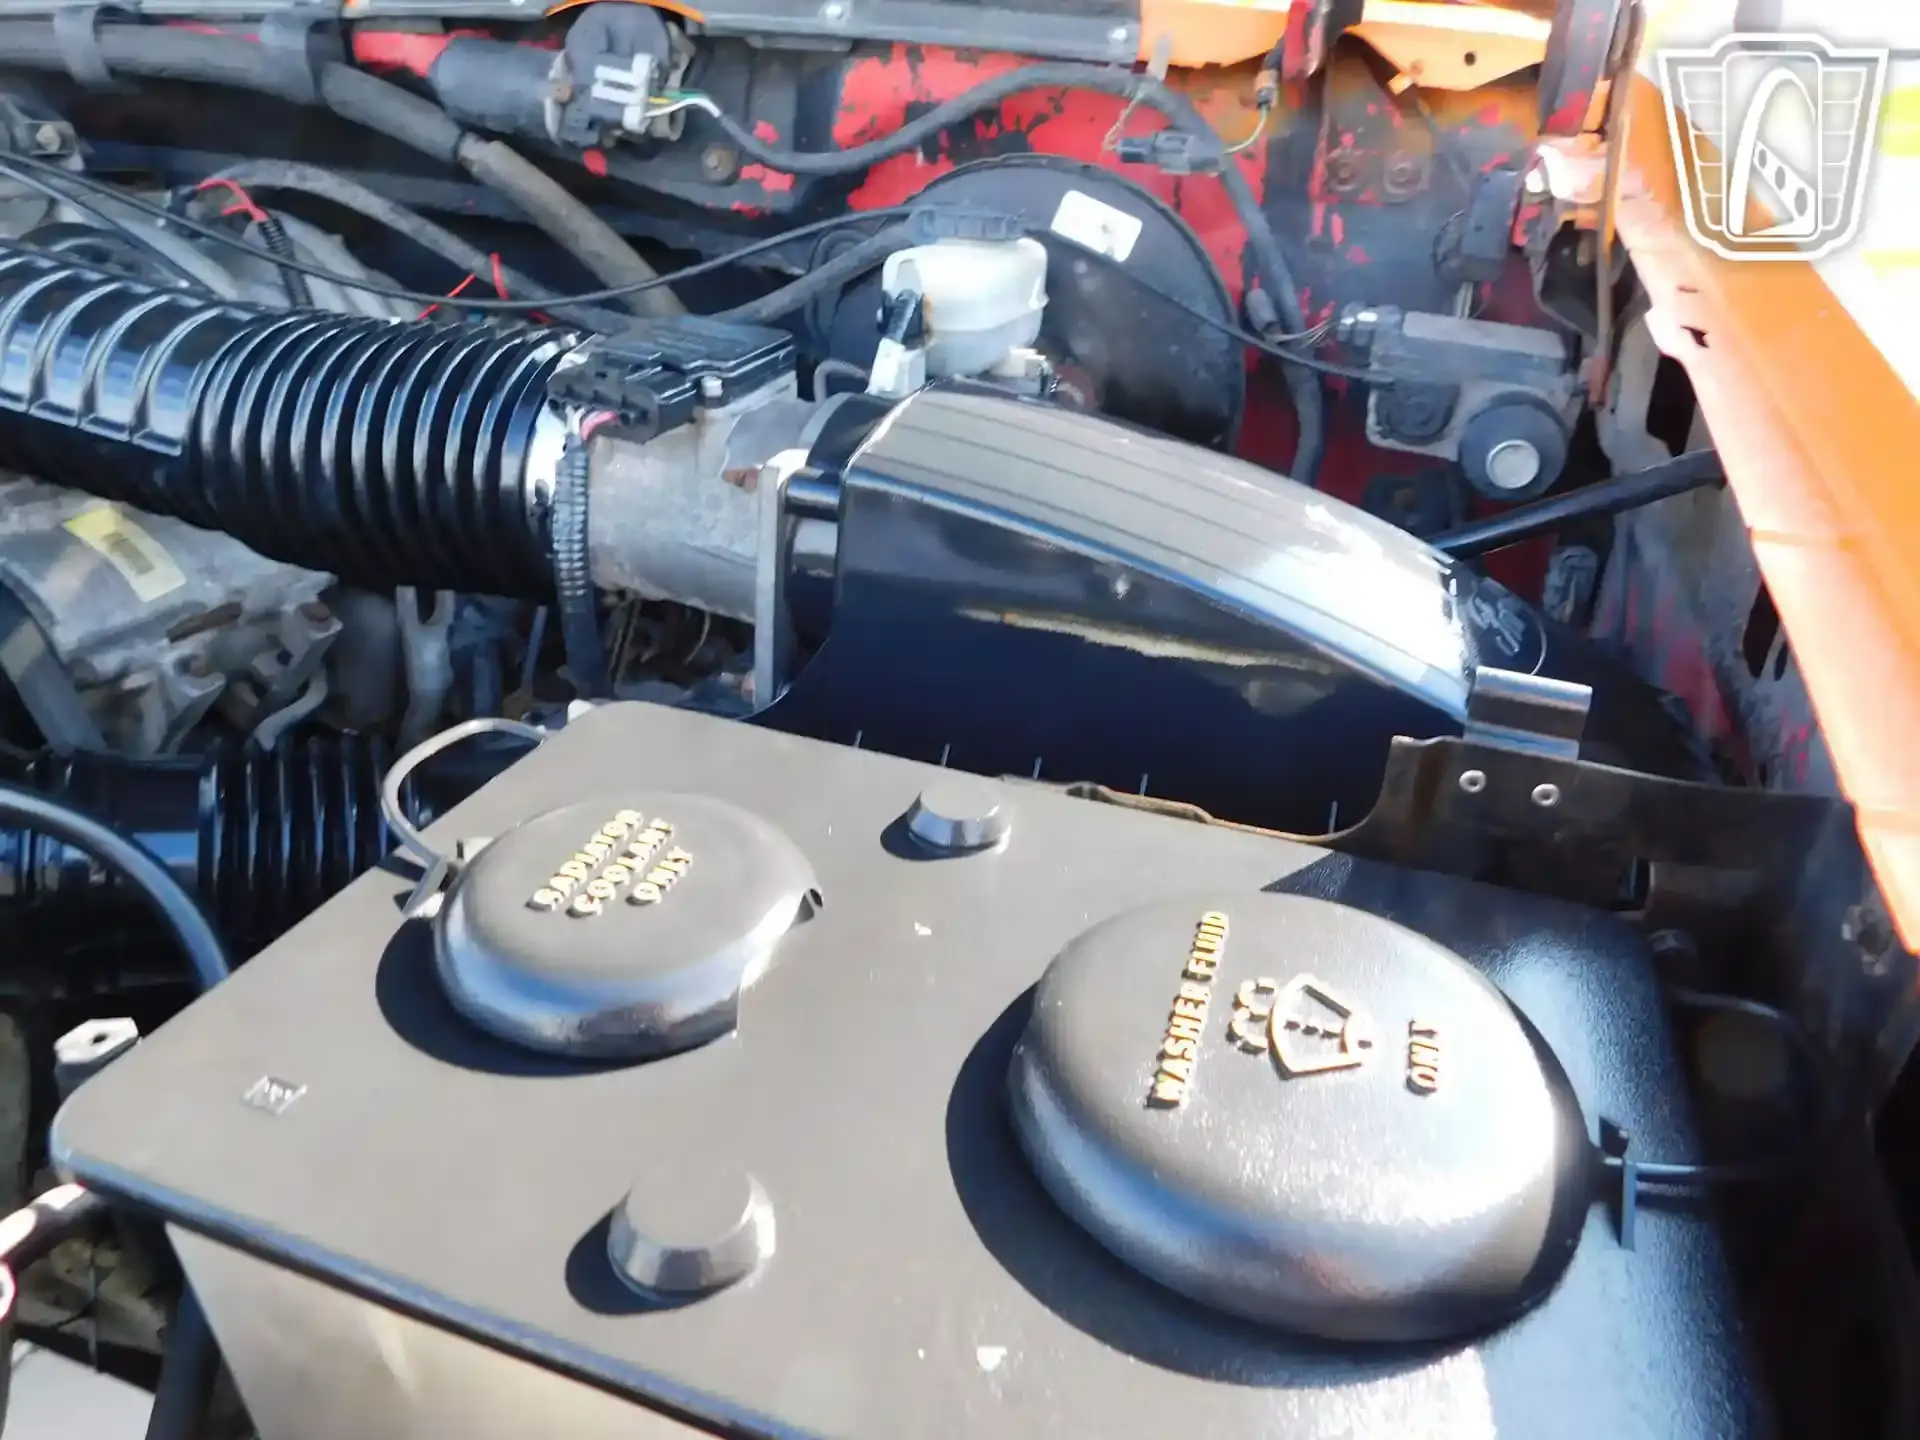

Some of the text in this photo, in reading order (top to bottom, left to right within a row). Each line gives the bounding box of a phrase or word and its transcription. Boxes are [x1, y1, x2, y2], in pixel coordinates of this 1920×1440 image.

[532, 809, 644, 911] RADIATOR
[572, 817, 674, 916] COOLANT
[632, 845, 693, 905] ONLY
[1148, 911, 1229, 1110] WASHER FLUID
